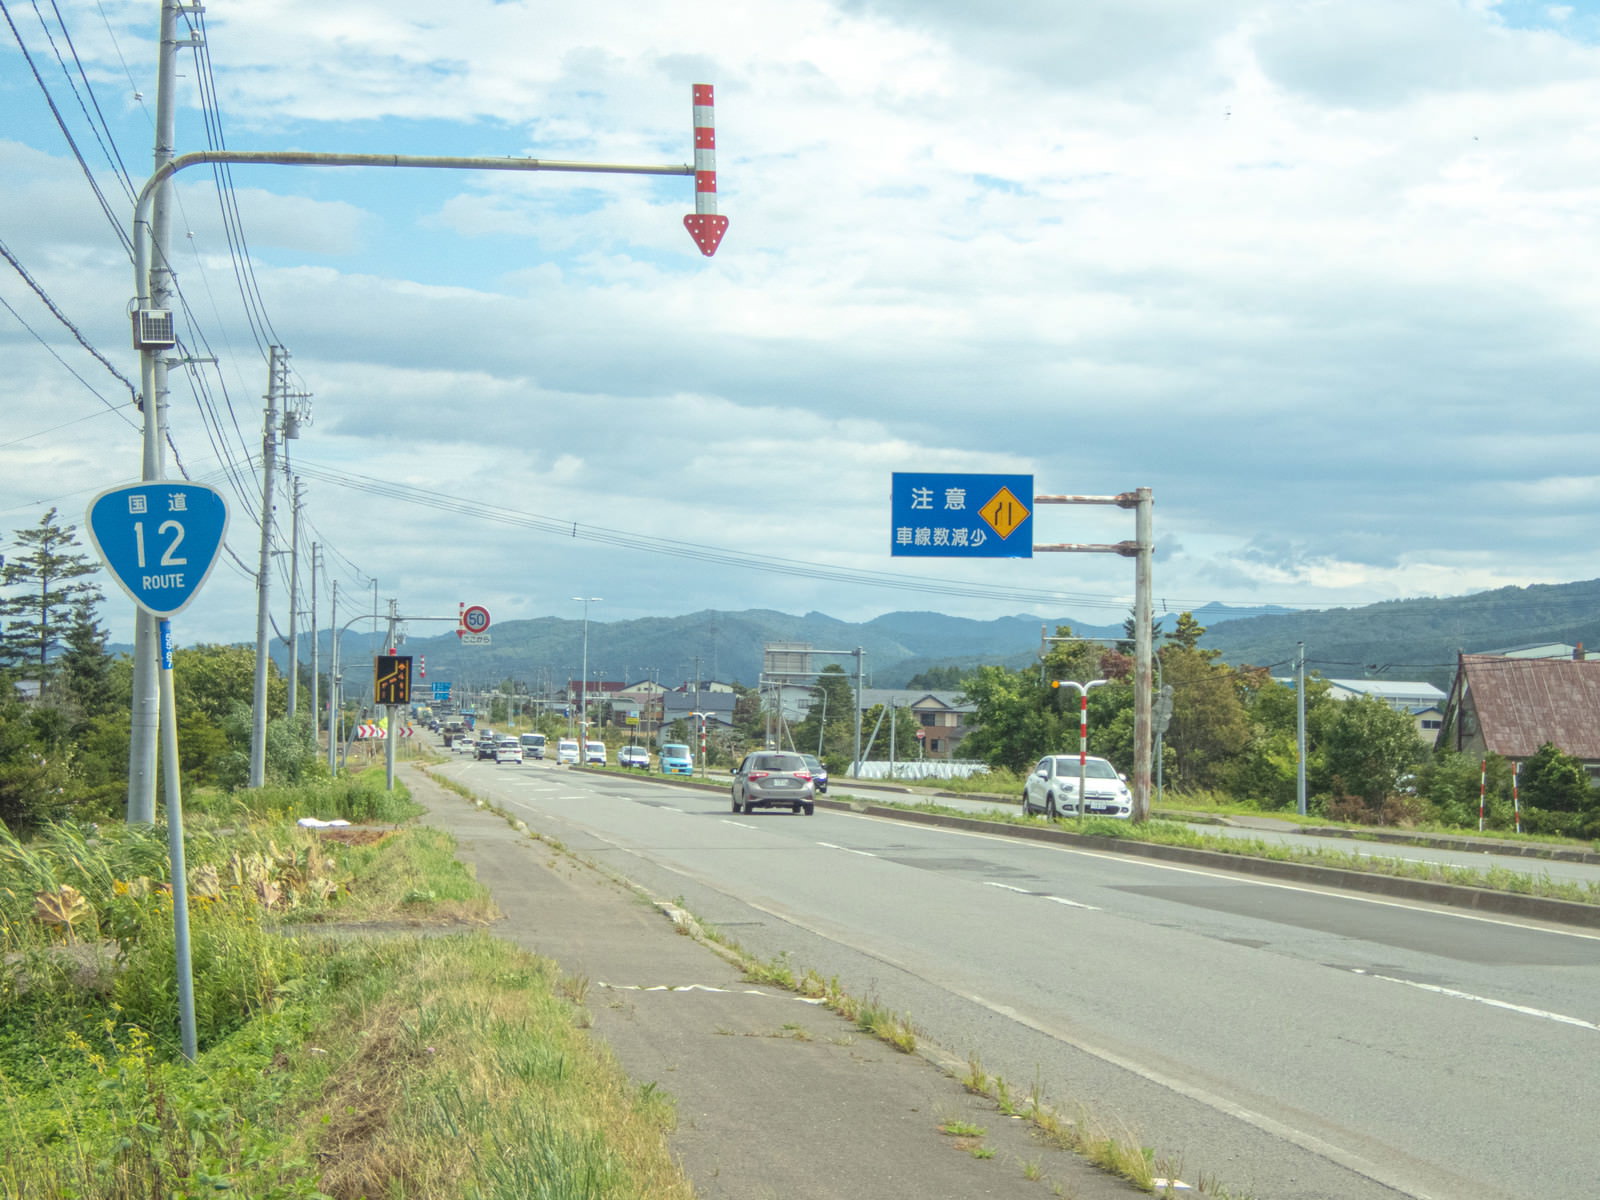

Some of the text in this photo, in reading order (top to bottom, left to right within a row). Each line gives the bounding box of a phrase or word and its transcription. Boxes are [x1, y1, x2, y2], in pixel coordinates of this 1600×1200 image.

[128, 492, 188, 514] 国道
[911, 487, 967, 510] 注意
[134, 520, 187, 567] 12
[896, 527, 987, 547] 車線数減少
[142, 573, 185, 590] ROUTE
[469, 613, 484, 626] 50
